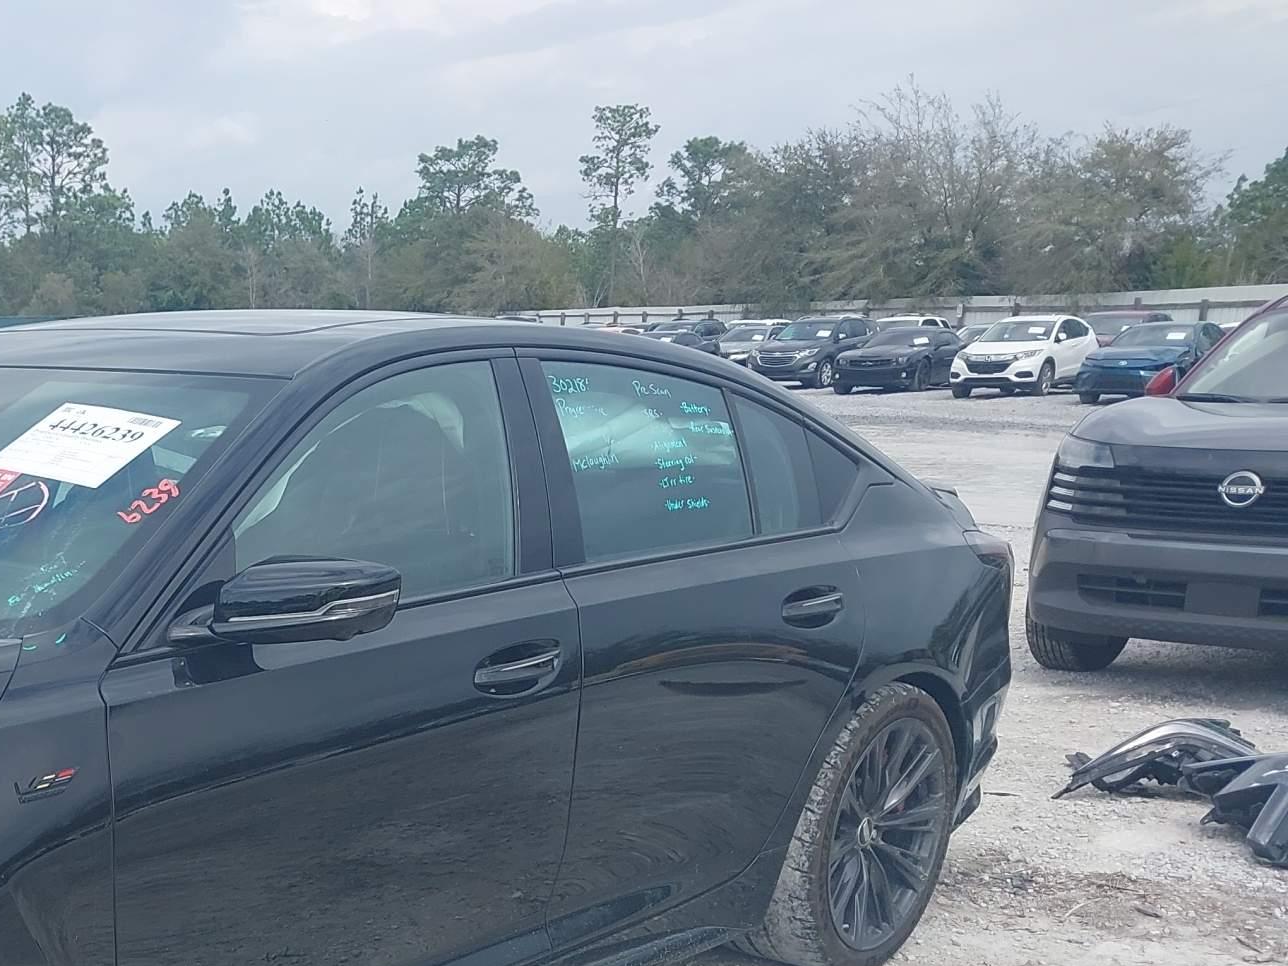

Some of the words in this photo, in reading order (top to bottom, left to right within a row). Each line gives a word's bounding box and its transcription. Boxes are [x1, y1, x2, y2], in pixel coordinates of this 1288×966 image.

[49, 418, 144, 444] 44426239
[117, 478, 180, 524] 6239
[1218, 485, 1265, 495] NISSAN
